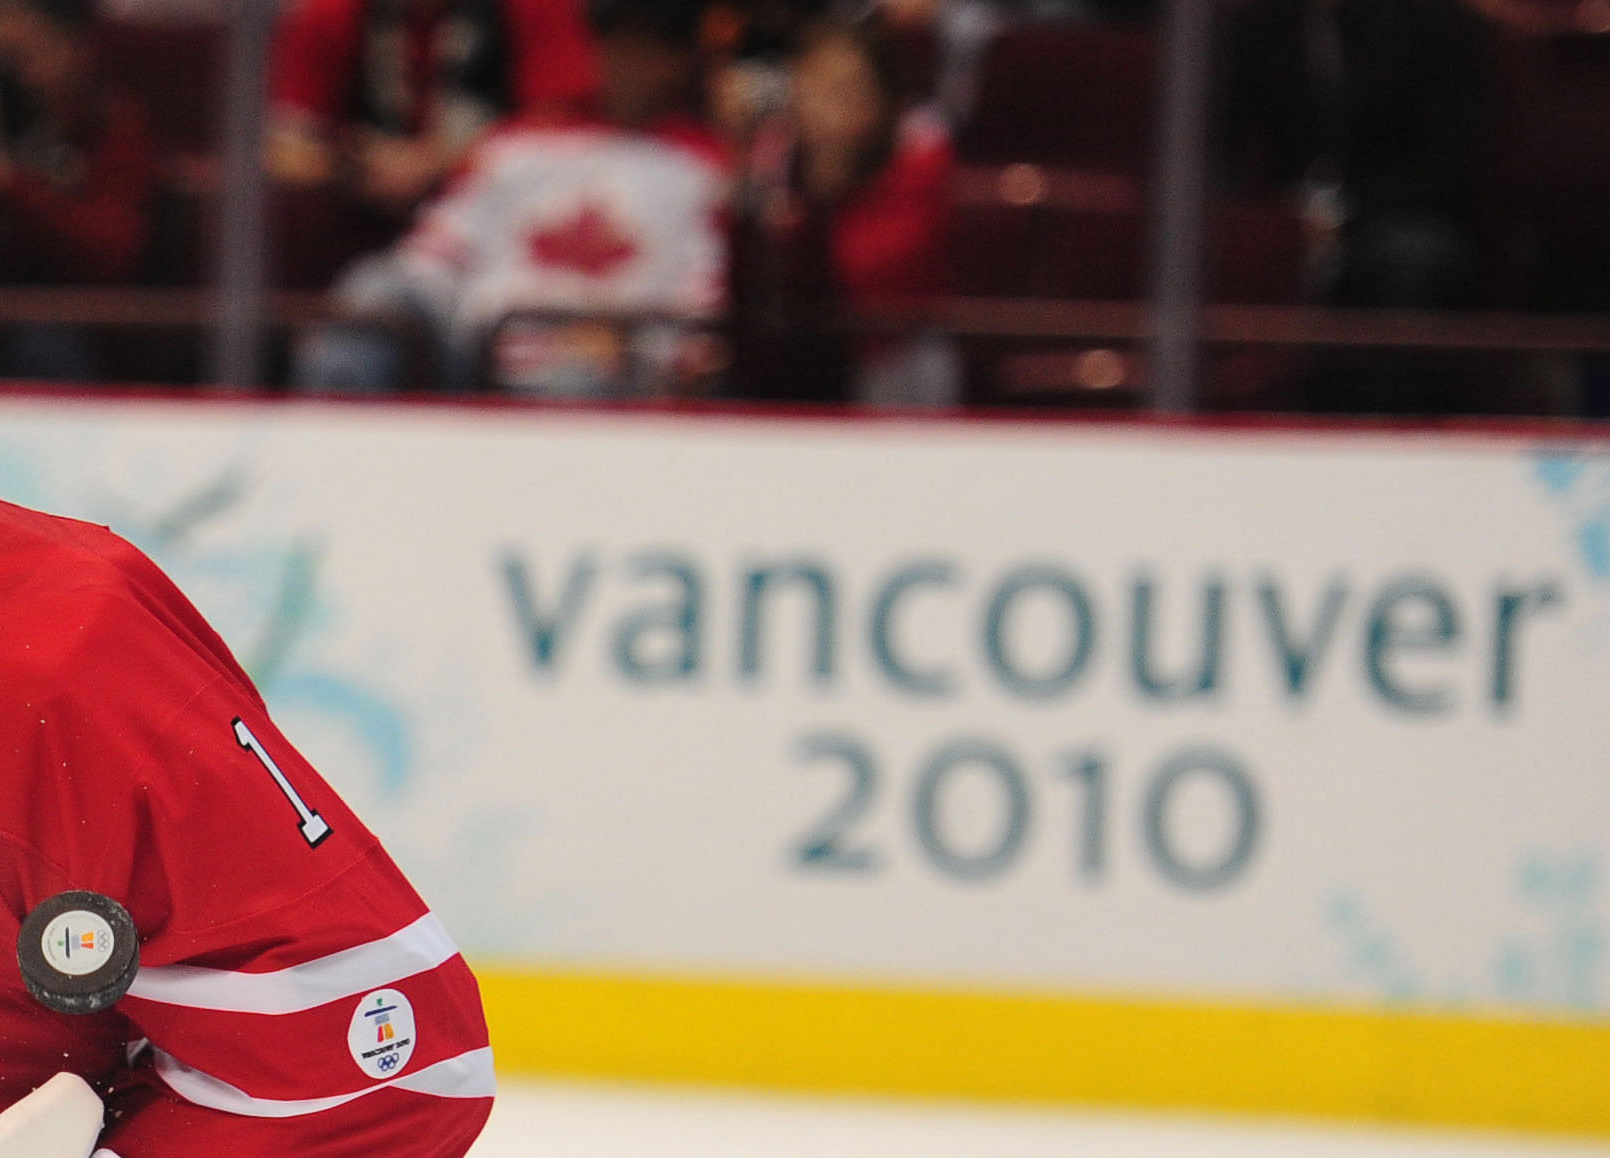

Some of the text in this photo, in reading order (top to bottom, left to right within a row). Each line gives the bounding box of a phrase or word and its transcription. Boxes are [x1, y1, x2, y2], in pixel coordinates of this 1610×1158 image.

[495, 546, 1562, 720] vancouver
[231, 716, 334, 850] 1
[788, 727, 1264, 894] 2010
